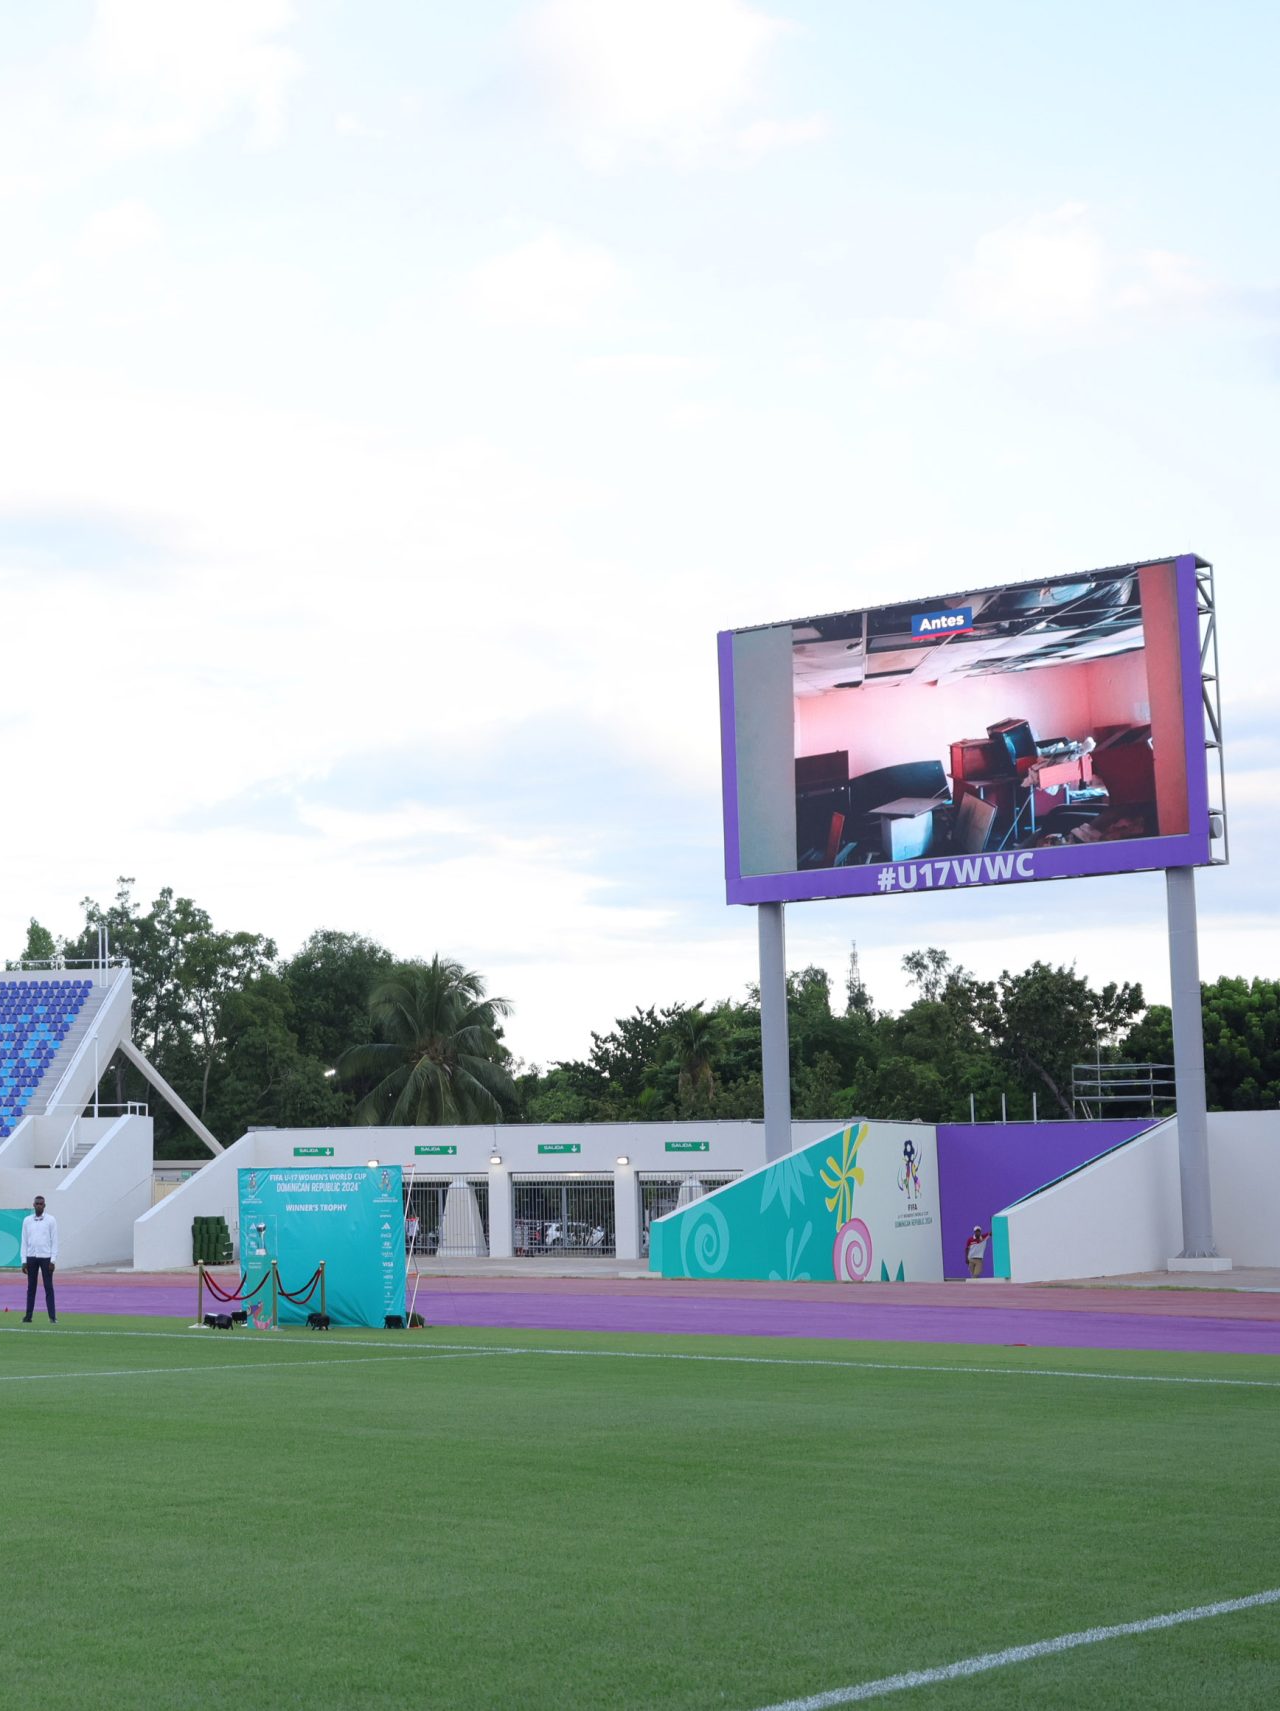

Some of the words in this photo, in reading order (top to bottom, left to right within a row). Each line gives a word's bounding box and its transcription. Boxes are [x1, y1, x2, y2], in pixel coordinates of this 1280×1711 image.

[920, 615, 964, 631] Antes
[877, 852, 1034, 891] #U17WWC
[276, 1183, 310, 1192] DOMINICAN
[311, 1182, 340, 1192] REPUBLIC
